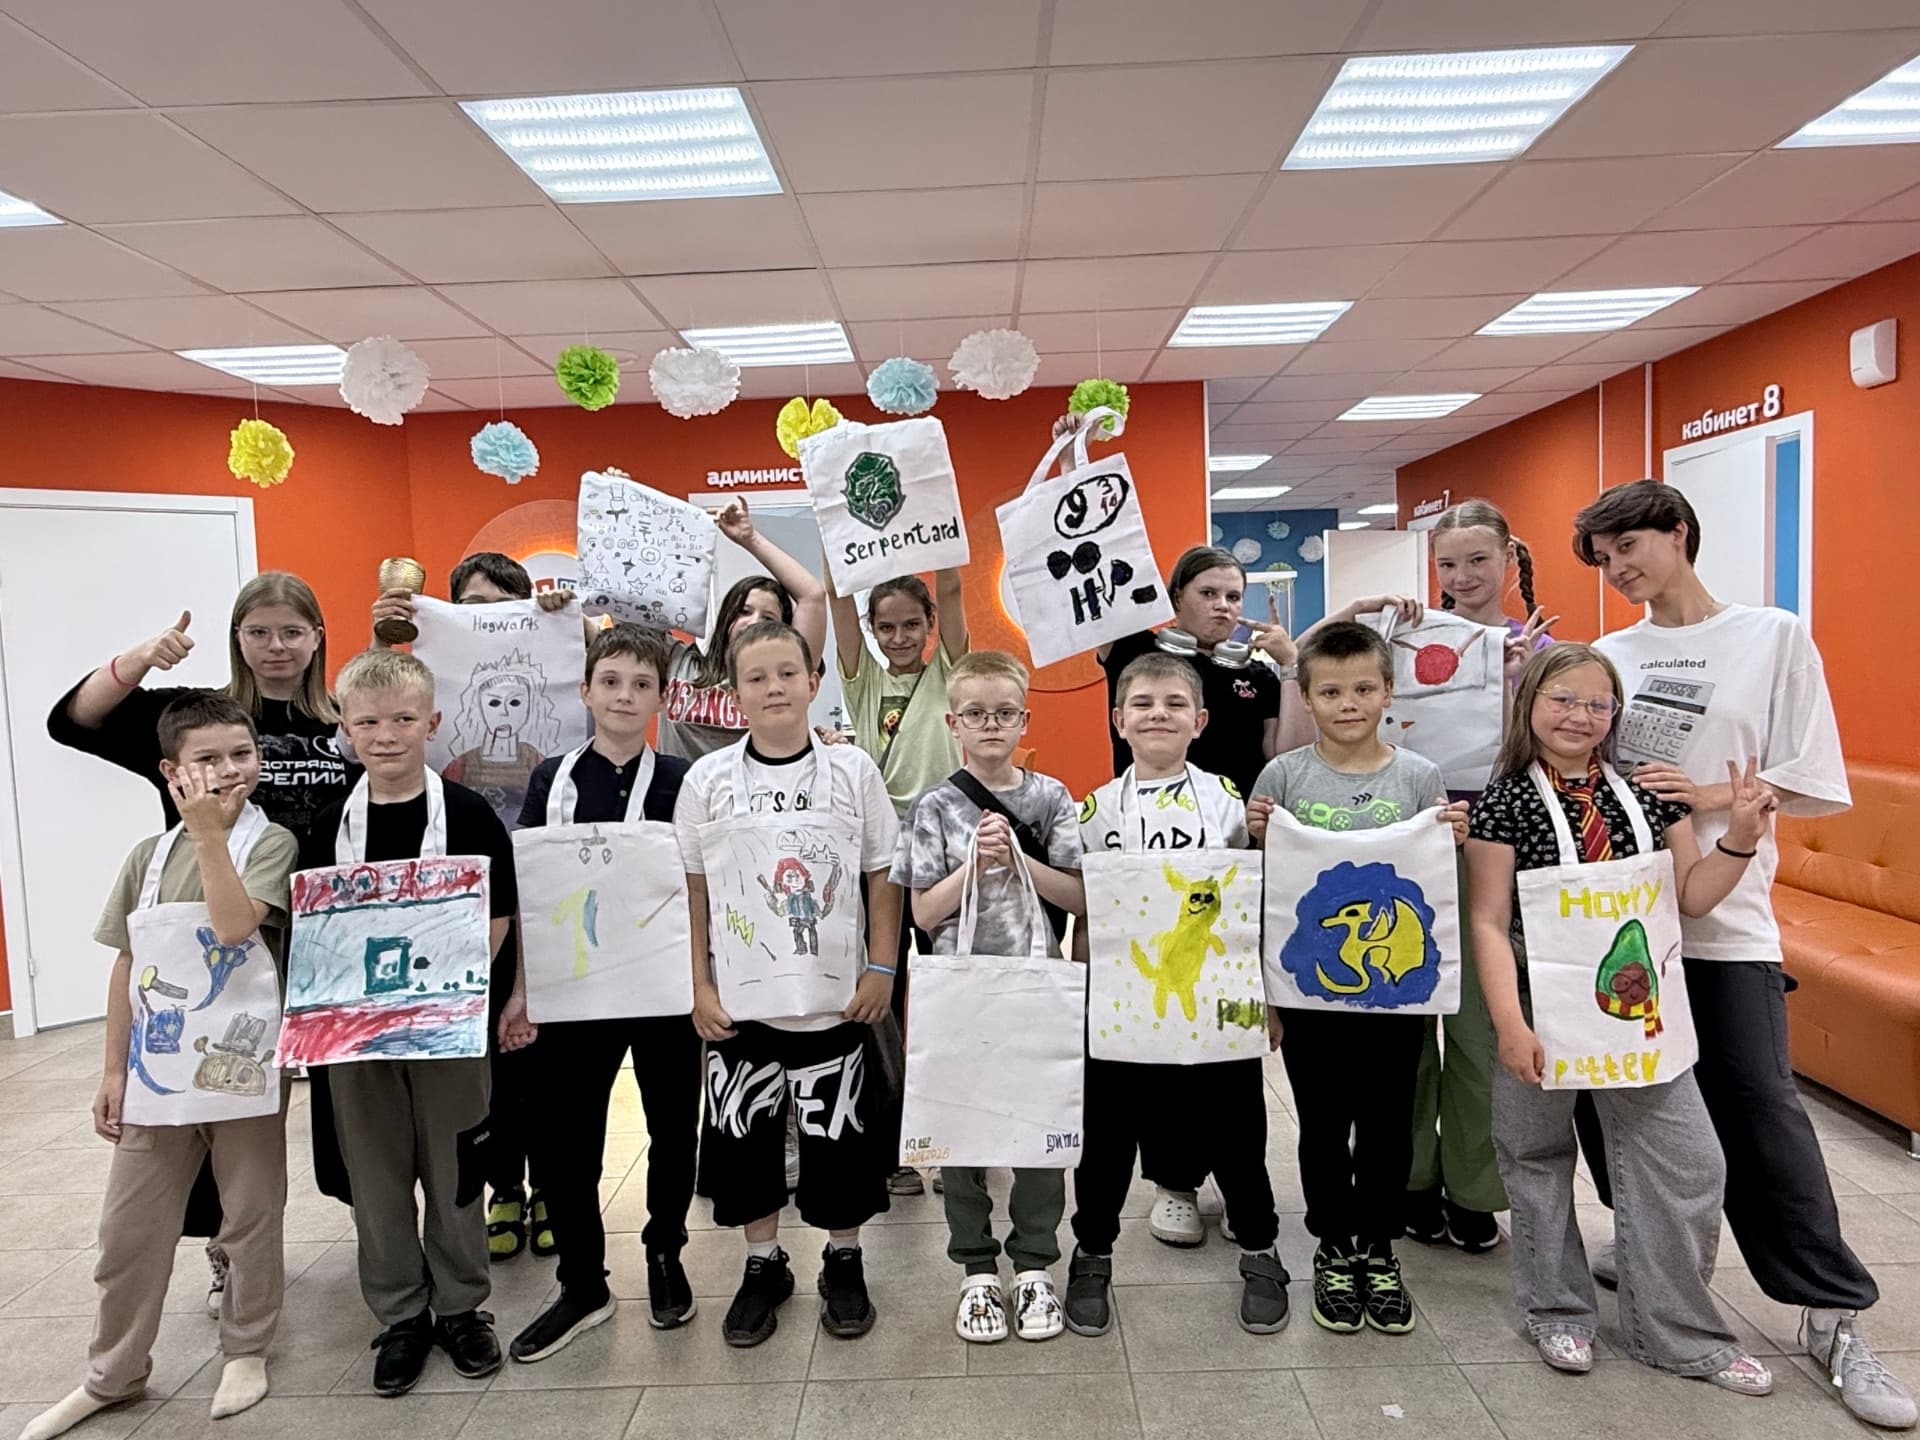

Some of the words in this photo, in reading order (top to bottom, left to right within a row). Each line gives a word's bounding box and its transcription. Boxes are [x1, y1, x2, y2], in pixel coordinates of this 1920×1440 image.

[1682, 402, 1759, 440] кабинет
[1763, 384, 1780, 417] 8
[1064, 488, 1088, 529] 9
[1443, 490, 1450, 509] 7
[844, 516, 960, 565] Serpentard
[1640, 659, 1706, 670] calculated
[684, 685, 749, 728] ANG
[258, 771, 347, 786] РЕЛИИ
[260, 760, 345, 771] ДОТРЯДЫ
